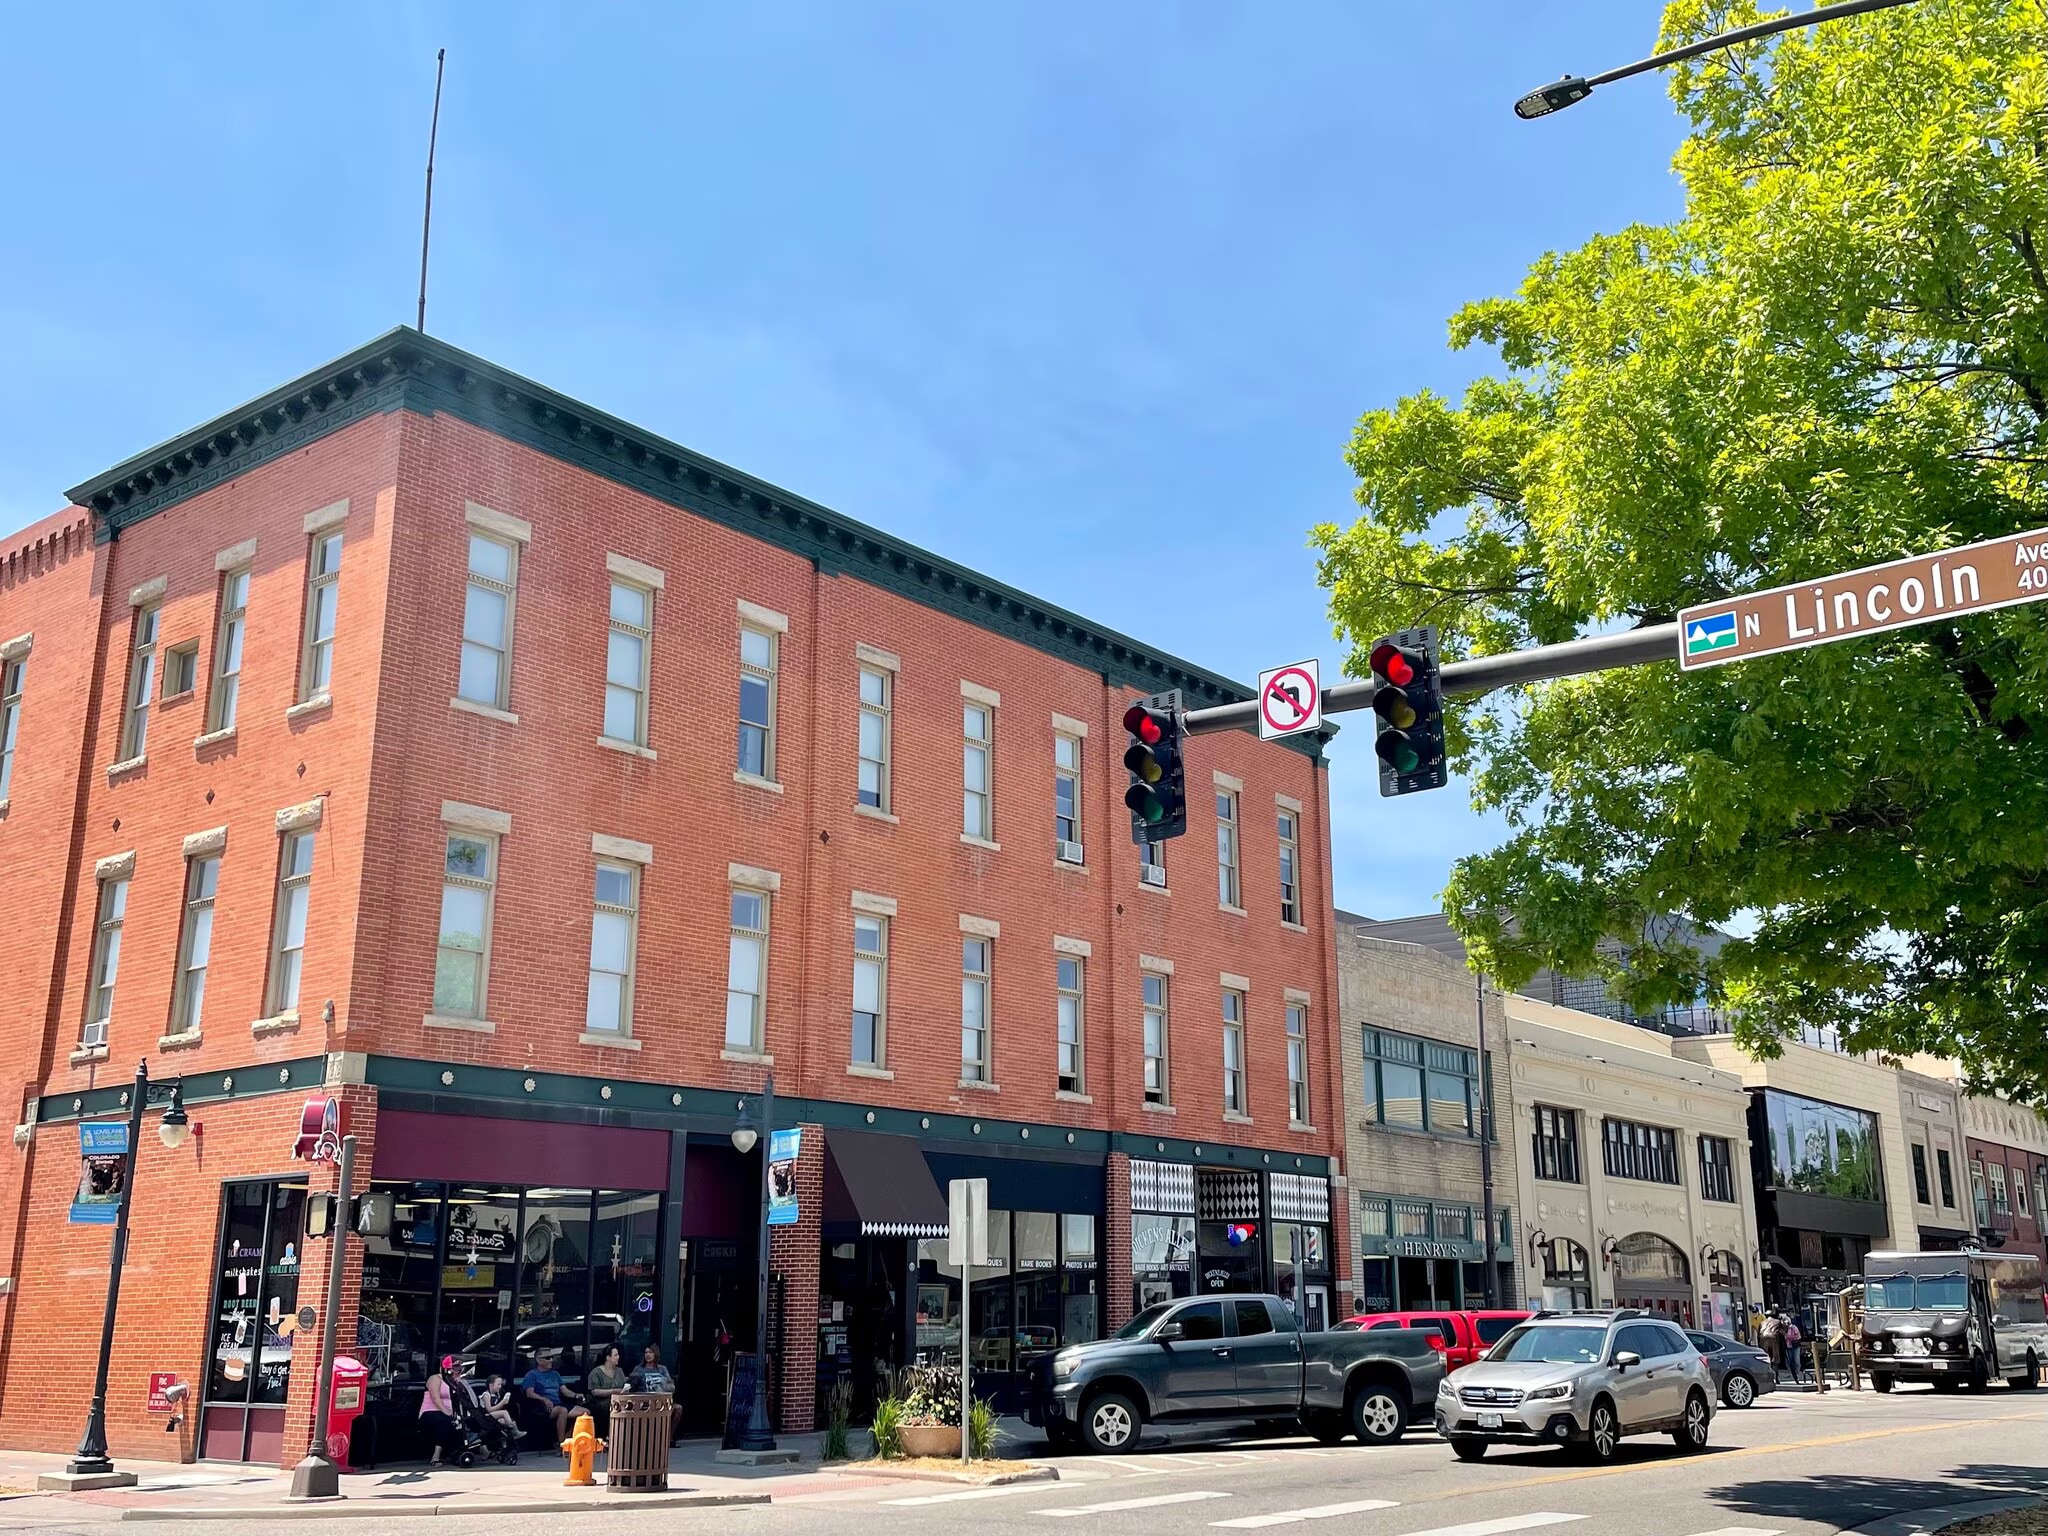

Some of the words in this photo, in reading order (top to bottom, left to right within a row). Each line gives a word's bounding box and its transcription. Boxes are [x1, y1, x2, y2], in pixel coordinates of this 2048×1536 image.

[2015, 543, 2048, 566] Ave
[1744, 613, 1761, 638] N
[1785, 562, 1980, 639] Lincoln
[1132, 1227, 1164, 1254] DICKENS
[239, 1247, 262, 1257] CREAM
[1404, 1241, 1458, 1258] HENRY'S
[1020, 1260, 1034, 1268] RARE
[1035, 1260, 1052, 1268] BOOKS
[1065, 1261, 1083, 1269] PHOTOS
[1146, 1263, 1159, 1271] BOOKS
[224, 1266, 261, 1277] milkshakes
[221, 1333, 231, 1342] ICE
[219, 1342, 239, 1350] CREAM
[261, 1364, 273, 1376] buy
[277, 1365, 288, 1377] get
